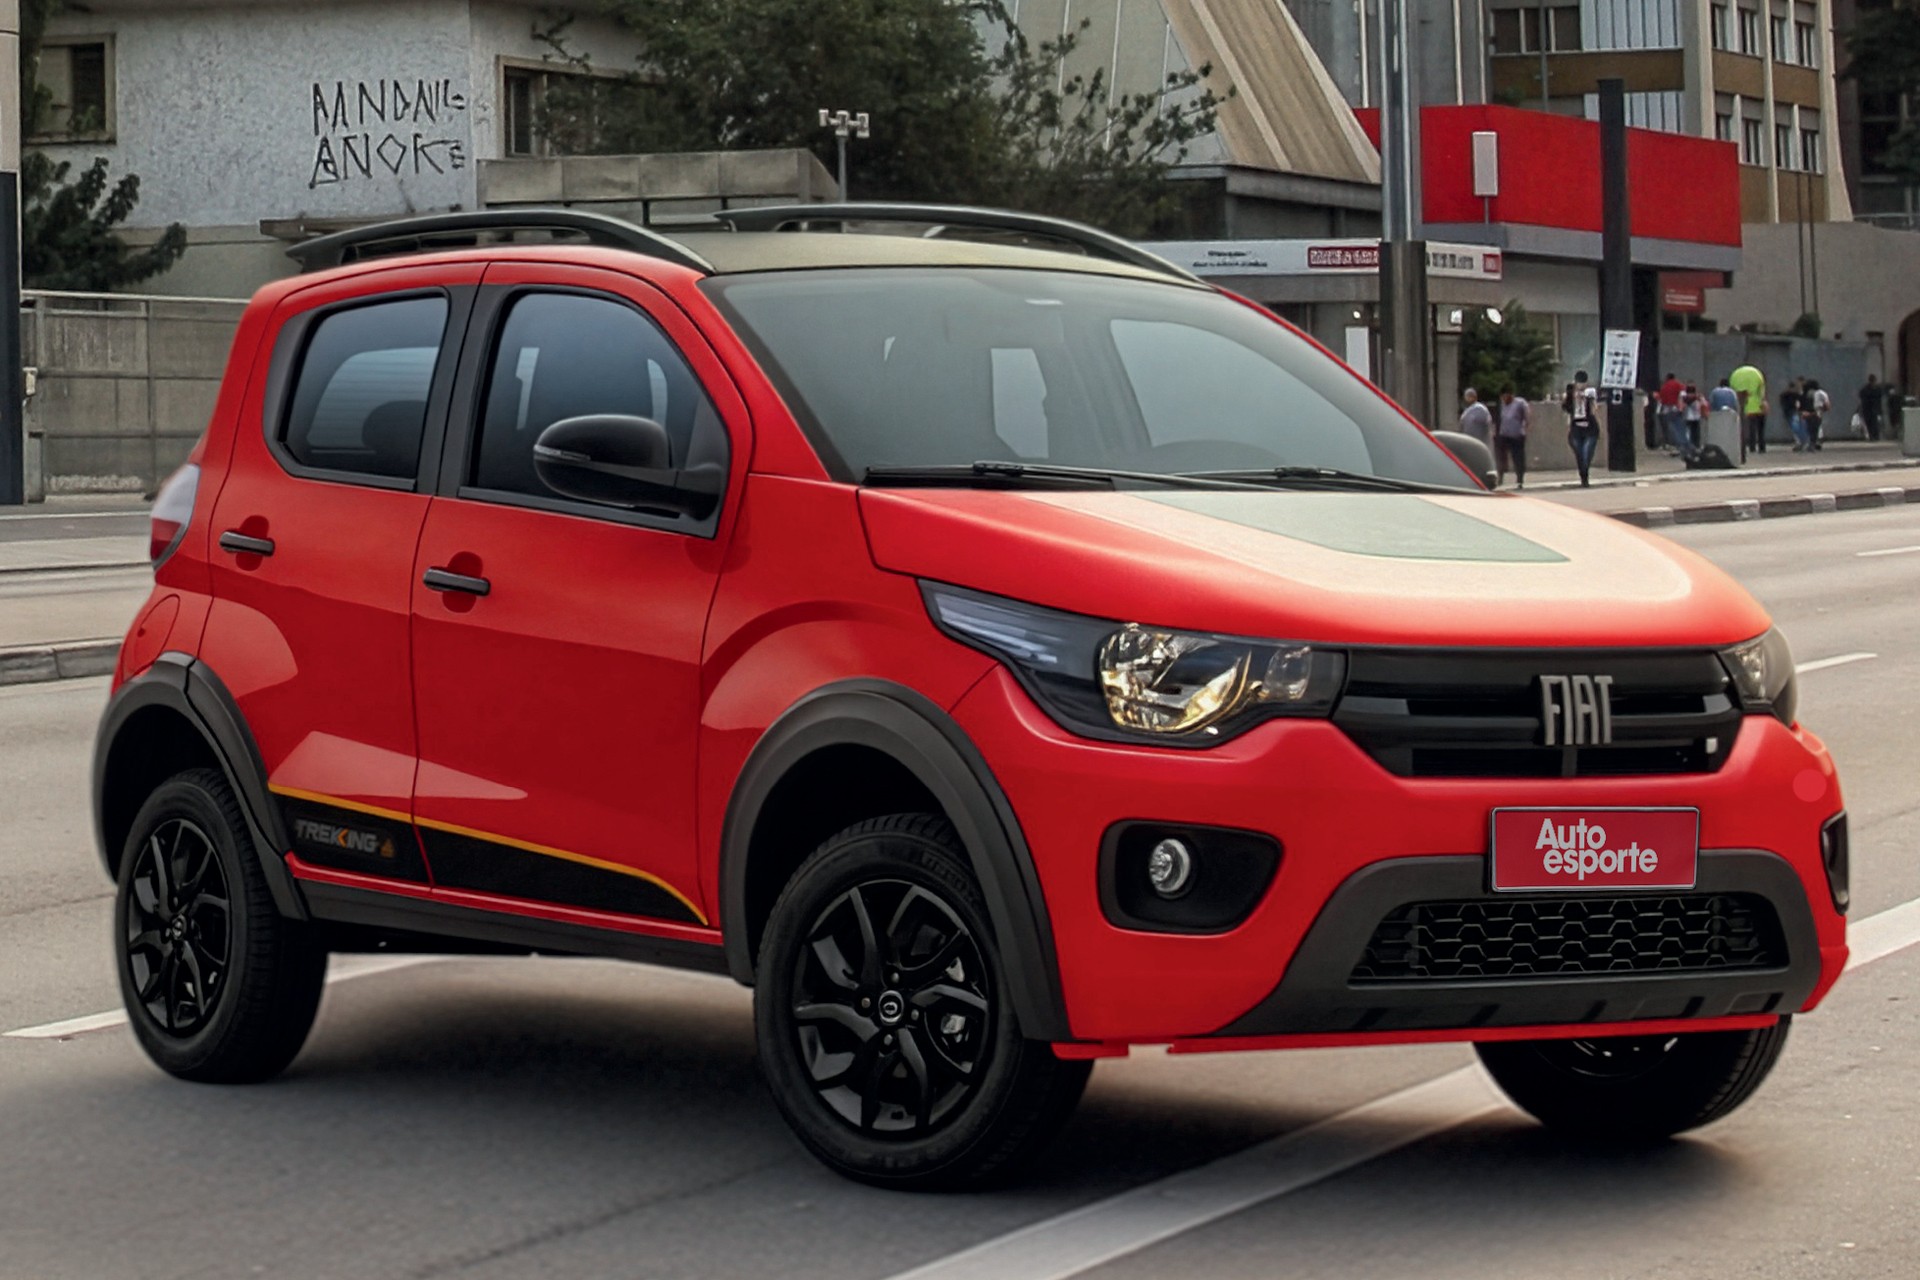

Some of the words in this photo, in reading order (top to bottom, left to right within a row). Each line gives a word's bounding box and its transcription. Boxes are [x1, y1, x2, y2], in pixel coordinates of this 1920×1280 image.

[1540, 674, 1613, 746] FIAT
[1535, 817, 1607, 850] Auto
[1543, 842, 1658, 881] esporte
